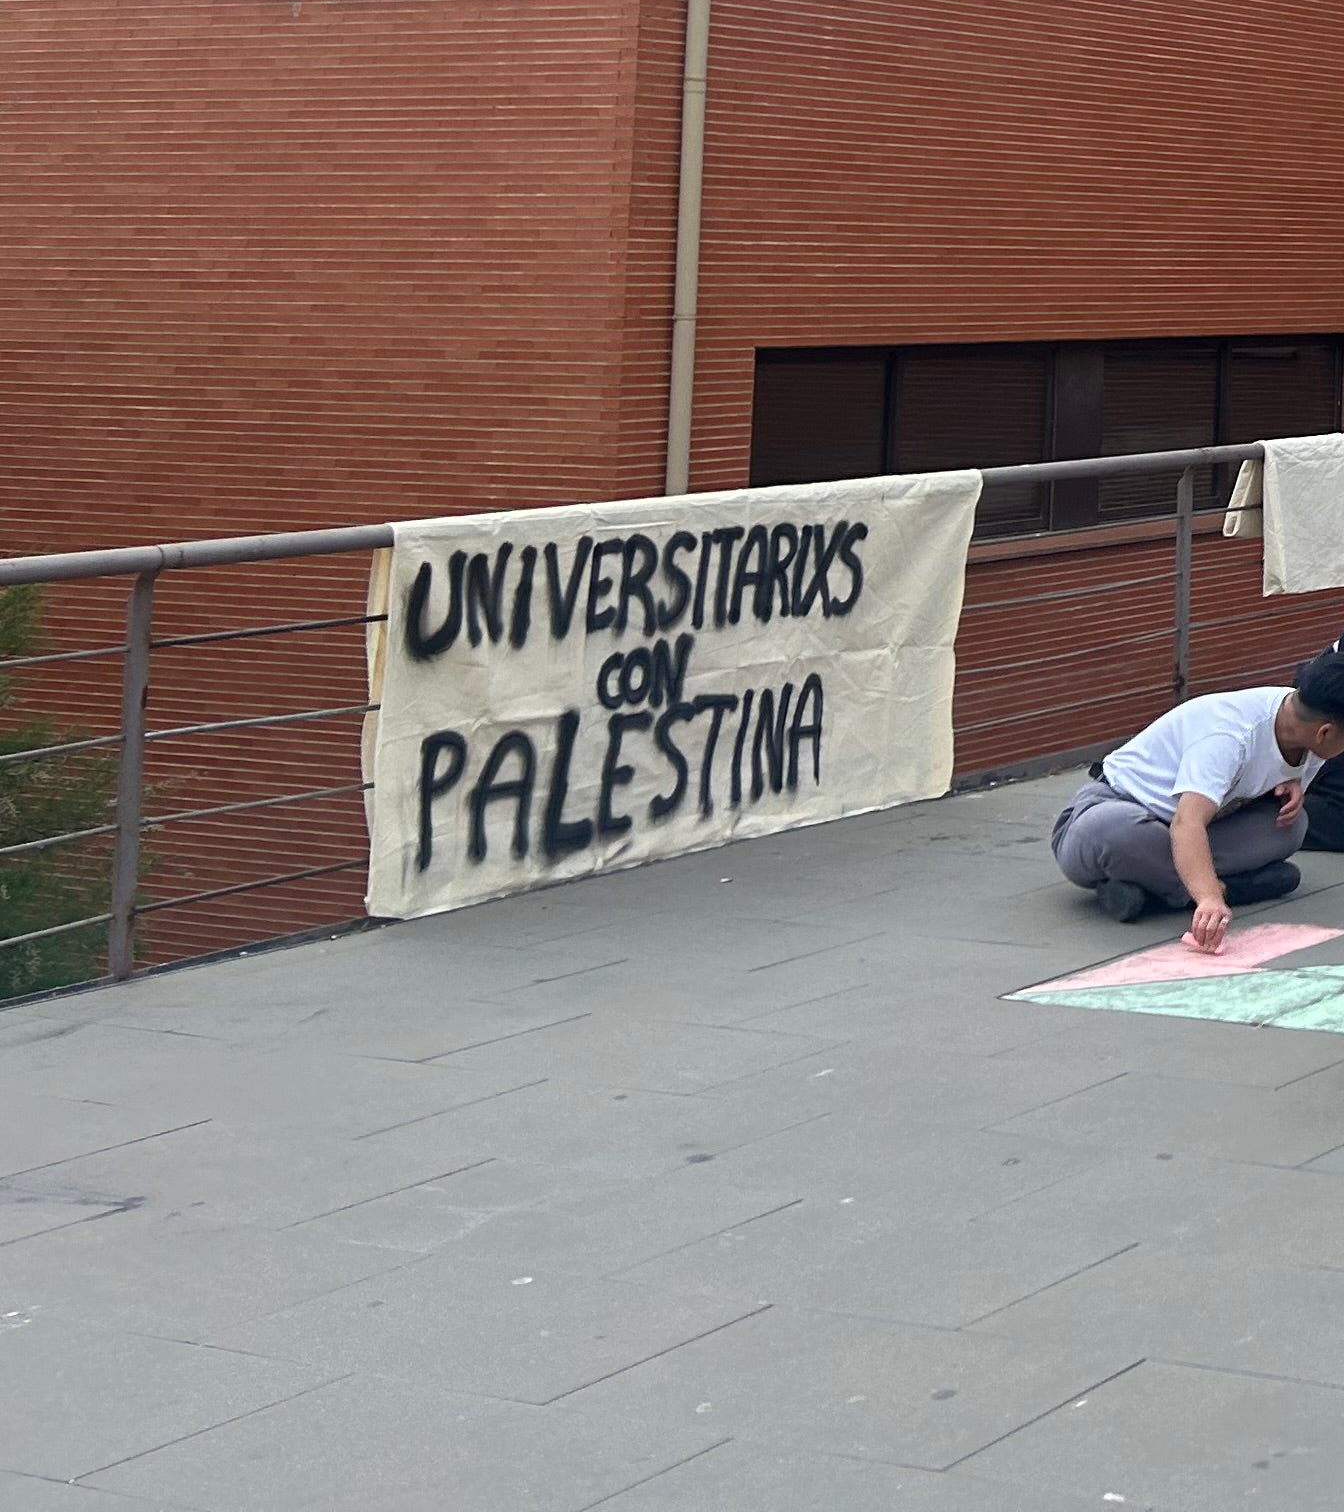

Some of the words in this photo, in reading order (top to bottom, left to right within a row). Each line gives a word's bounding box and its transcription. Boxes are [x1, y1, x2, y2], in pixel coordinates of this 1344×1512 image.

[404, 520, 869, 661] UNIVERSITARIXS
[596, 634, 695, 710] CON
[416, 672, 825, 873] PALESTINA
